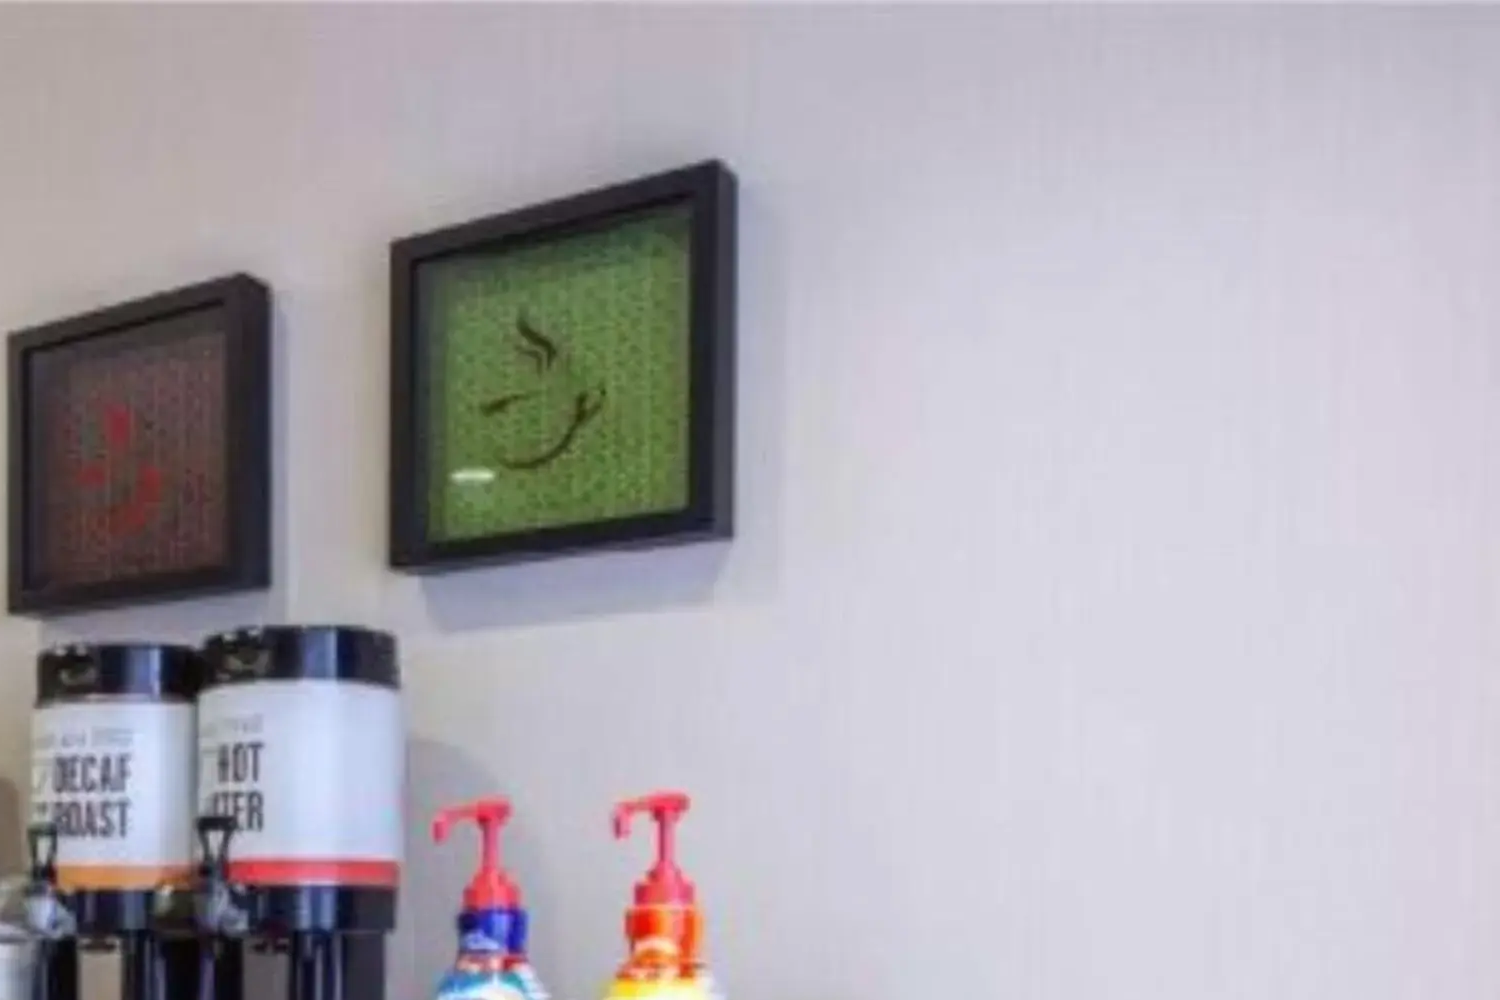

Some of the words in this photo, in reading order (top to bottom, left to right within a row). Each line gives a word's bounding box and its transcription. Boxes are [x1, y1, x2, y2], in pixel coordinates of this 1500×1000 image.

[52, 752, 132, 793] DECAF
[217, 742, 264, 783] HOT
[53, 800, 132, 838] ROAST
